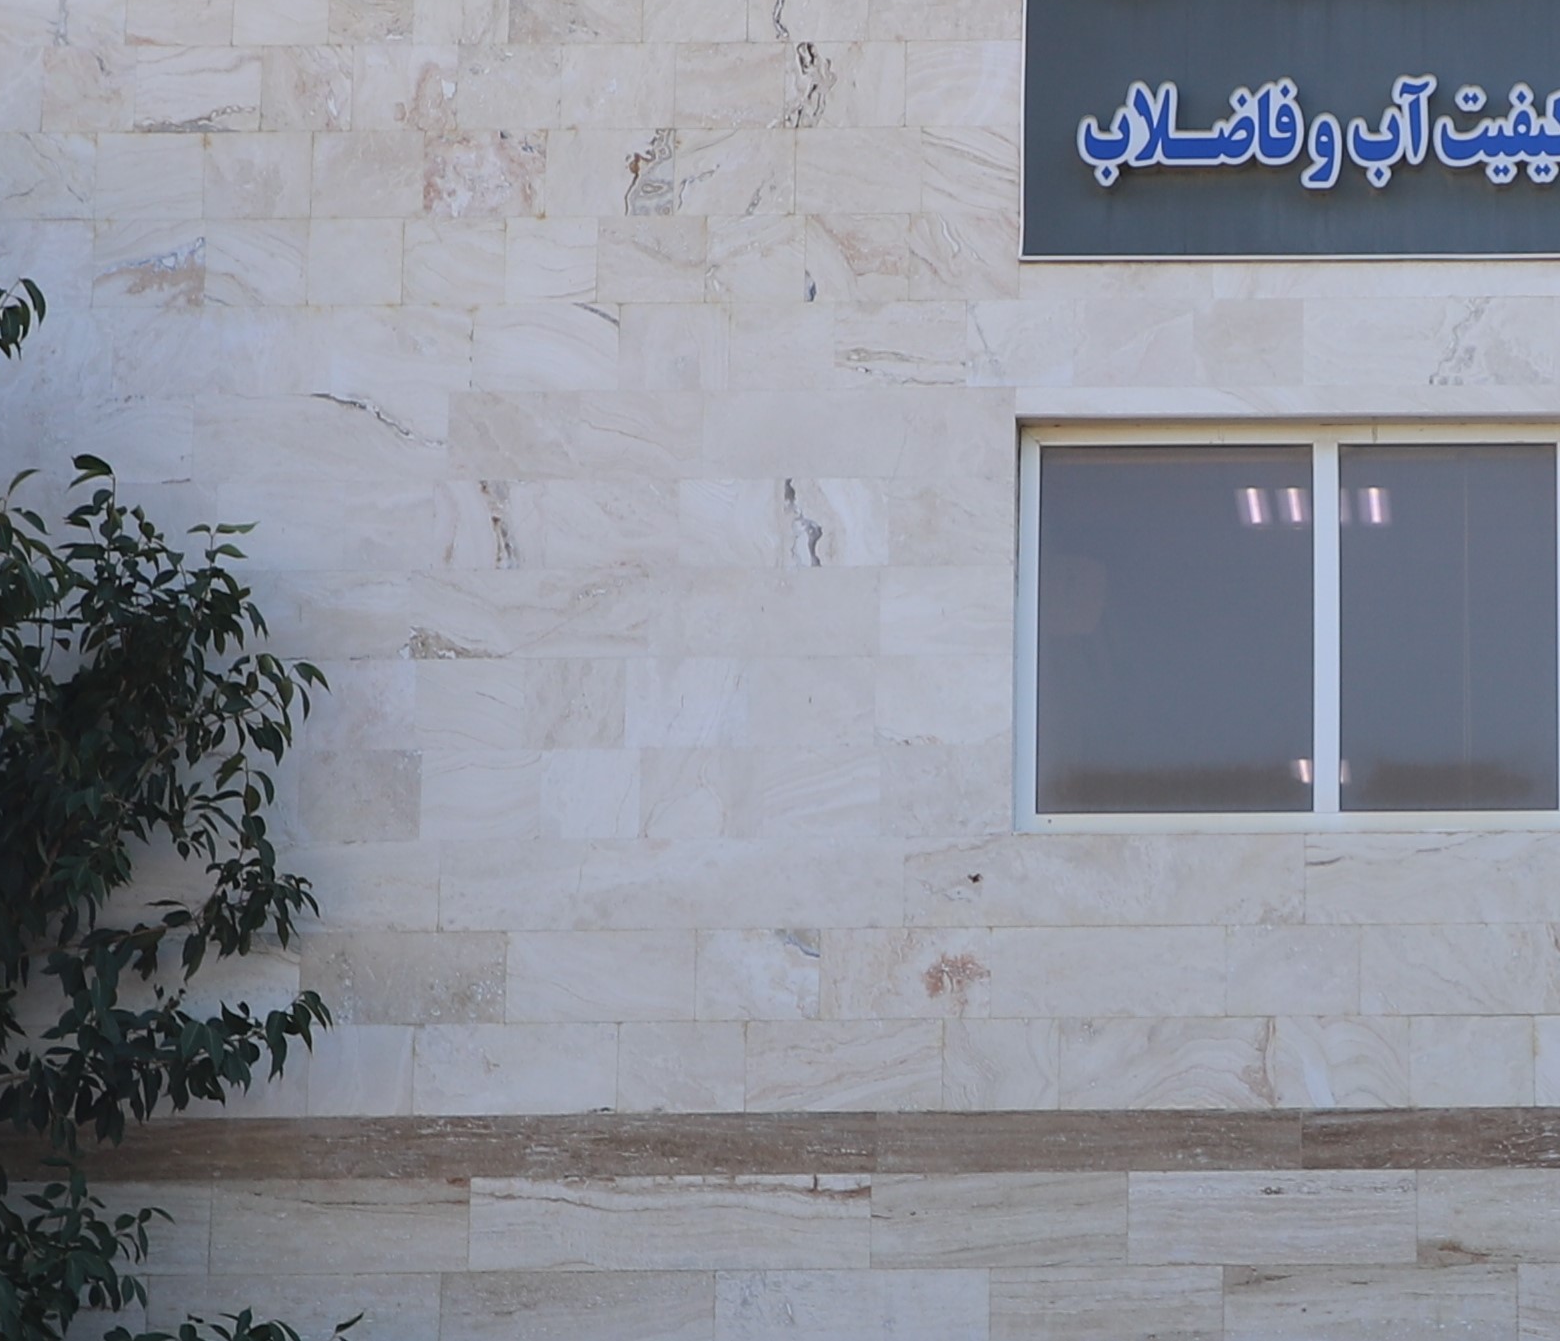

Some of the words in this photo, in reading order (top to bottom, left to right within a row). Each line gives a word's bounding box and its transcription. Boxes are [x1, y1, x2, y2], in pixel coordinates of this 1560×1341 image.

[1079, 80, 1302, 185] فاضلاب
[1303, 115, 1340, 187] و
[1349, 76, 1435, 186] آب
